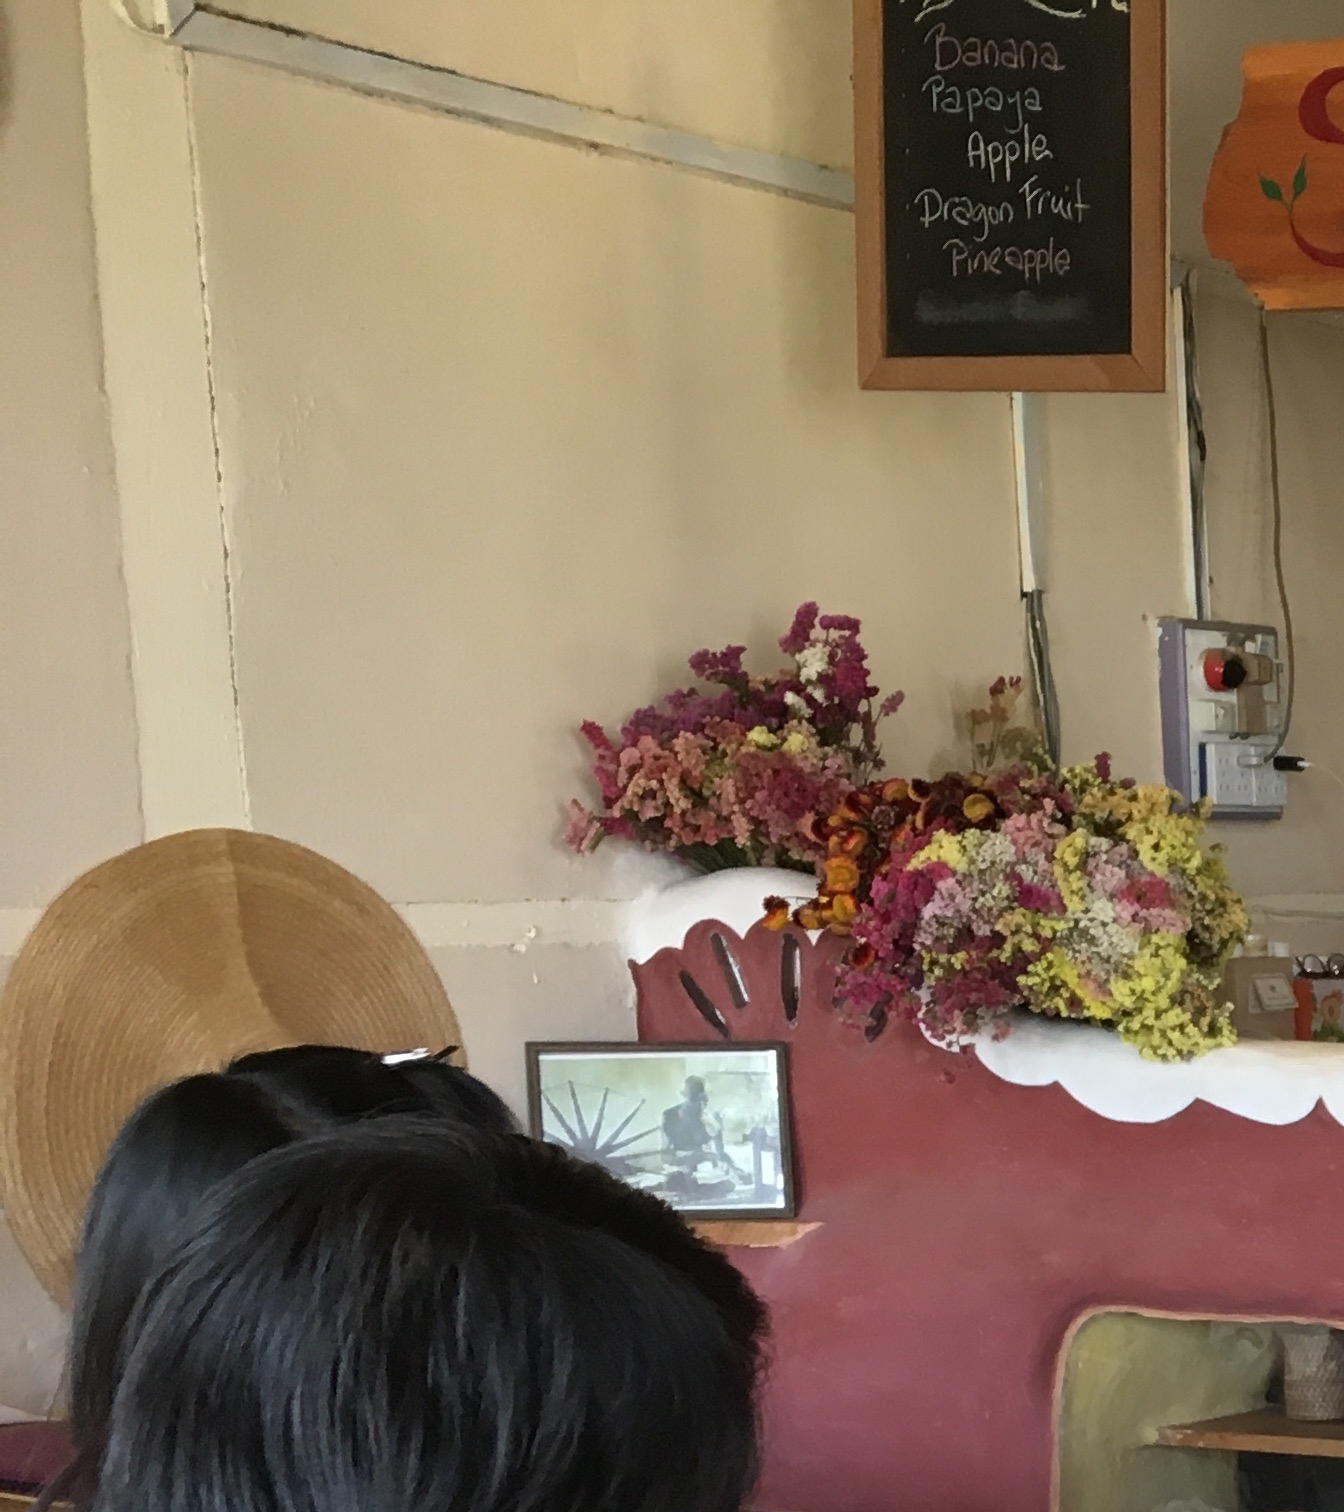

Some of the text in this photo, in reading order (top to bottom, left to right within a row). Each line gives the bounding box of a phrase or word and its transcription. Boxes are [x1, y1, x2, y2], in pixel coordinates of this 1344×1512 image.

[923, 22, 1066, 71] Banana
[922, 75, 1043, 134] Papaya
[967, 124, 1053, 183] Apple
[914, 174, 1092, 243] Dragon Fruit
[942, 237, 1072, 285] Pineapple
